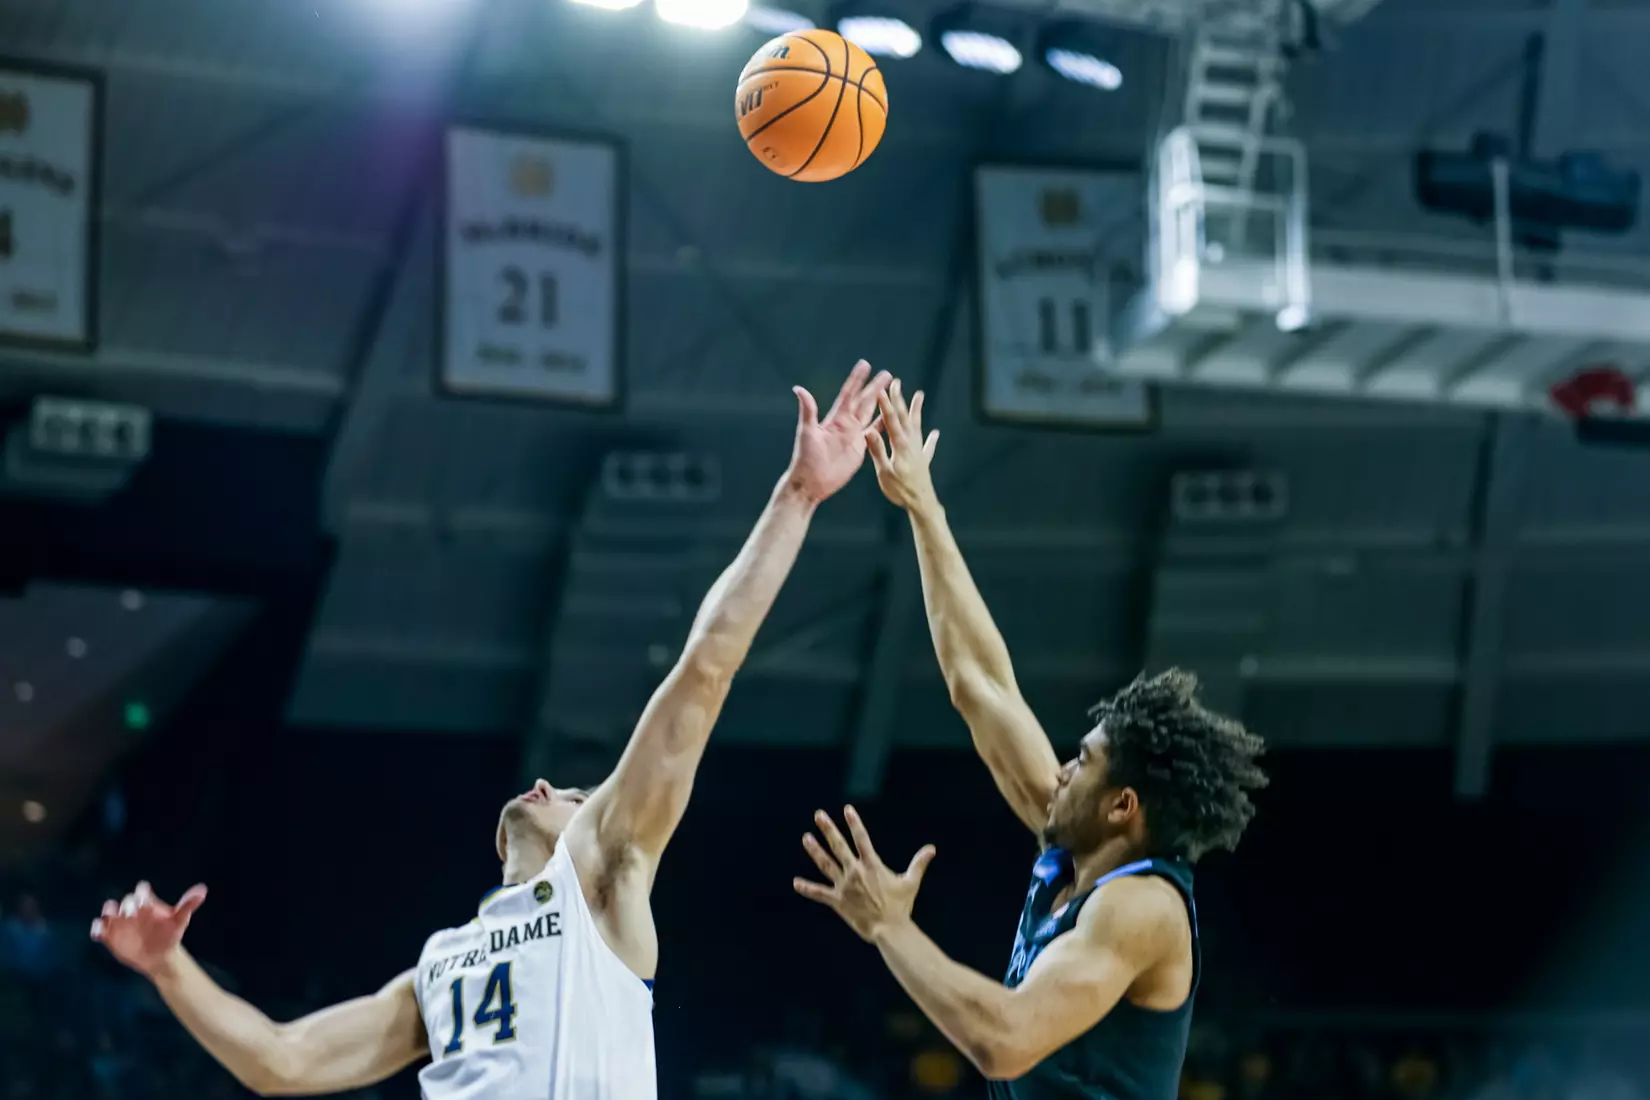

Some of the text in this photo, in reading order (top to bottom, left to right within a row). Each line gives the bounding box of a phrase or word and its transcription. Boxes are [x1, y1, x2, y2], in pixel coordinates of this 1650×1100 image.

[498, 265, 560, 329] 21
[1038, 297, 1092, 355] 11
[490, 911, 562, 953] DAME
[442, 960, 518, 1058] 14
